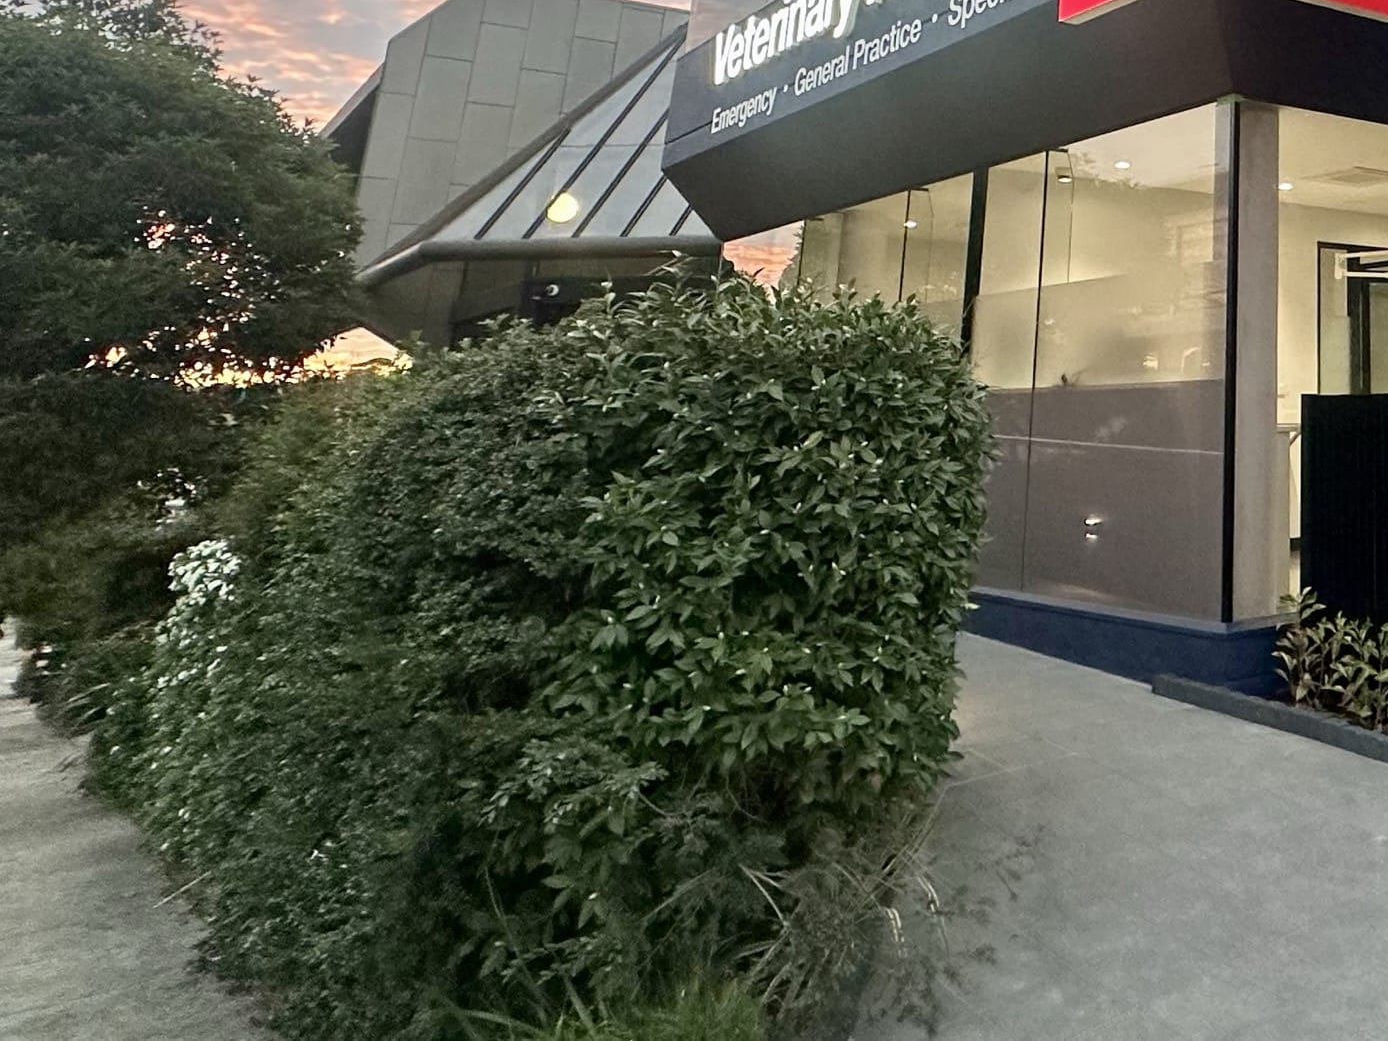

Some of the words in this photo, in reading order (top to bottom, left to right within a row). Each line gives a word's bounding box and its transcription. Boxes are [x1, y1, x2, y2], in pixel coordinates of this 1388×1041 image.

[710, 87, 777, 134] Emergency
[794, 49, 850, 97] General
[852, 18, 922, 70] Practice
